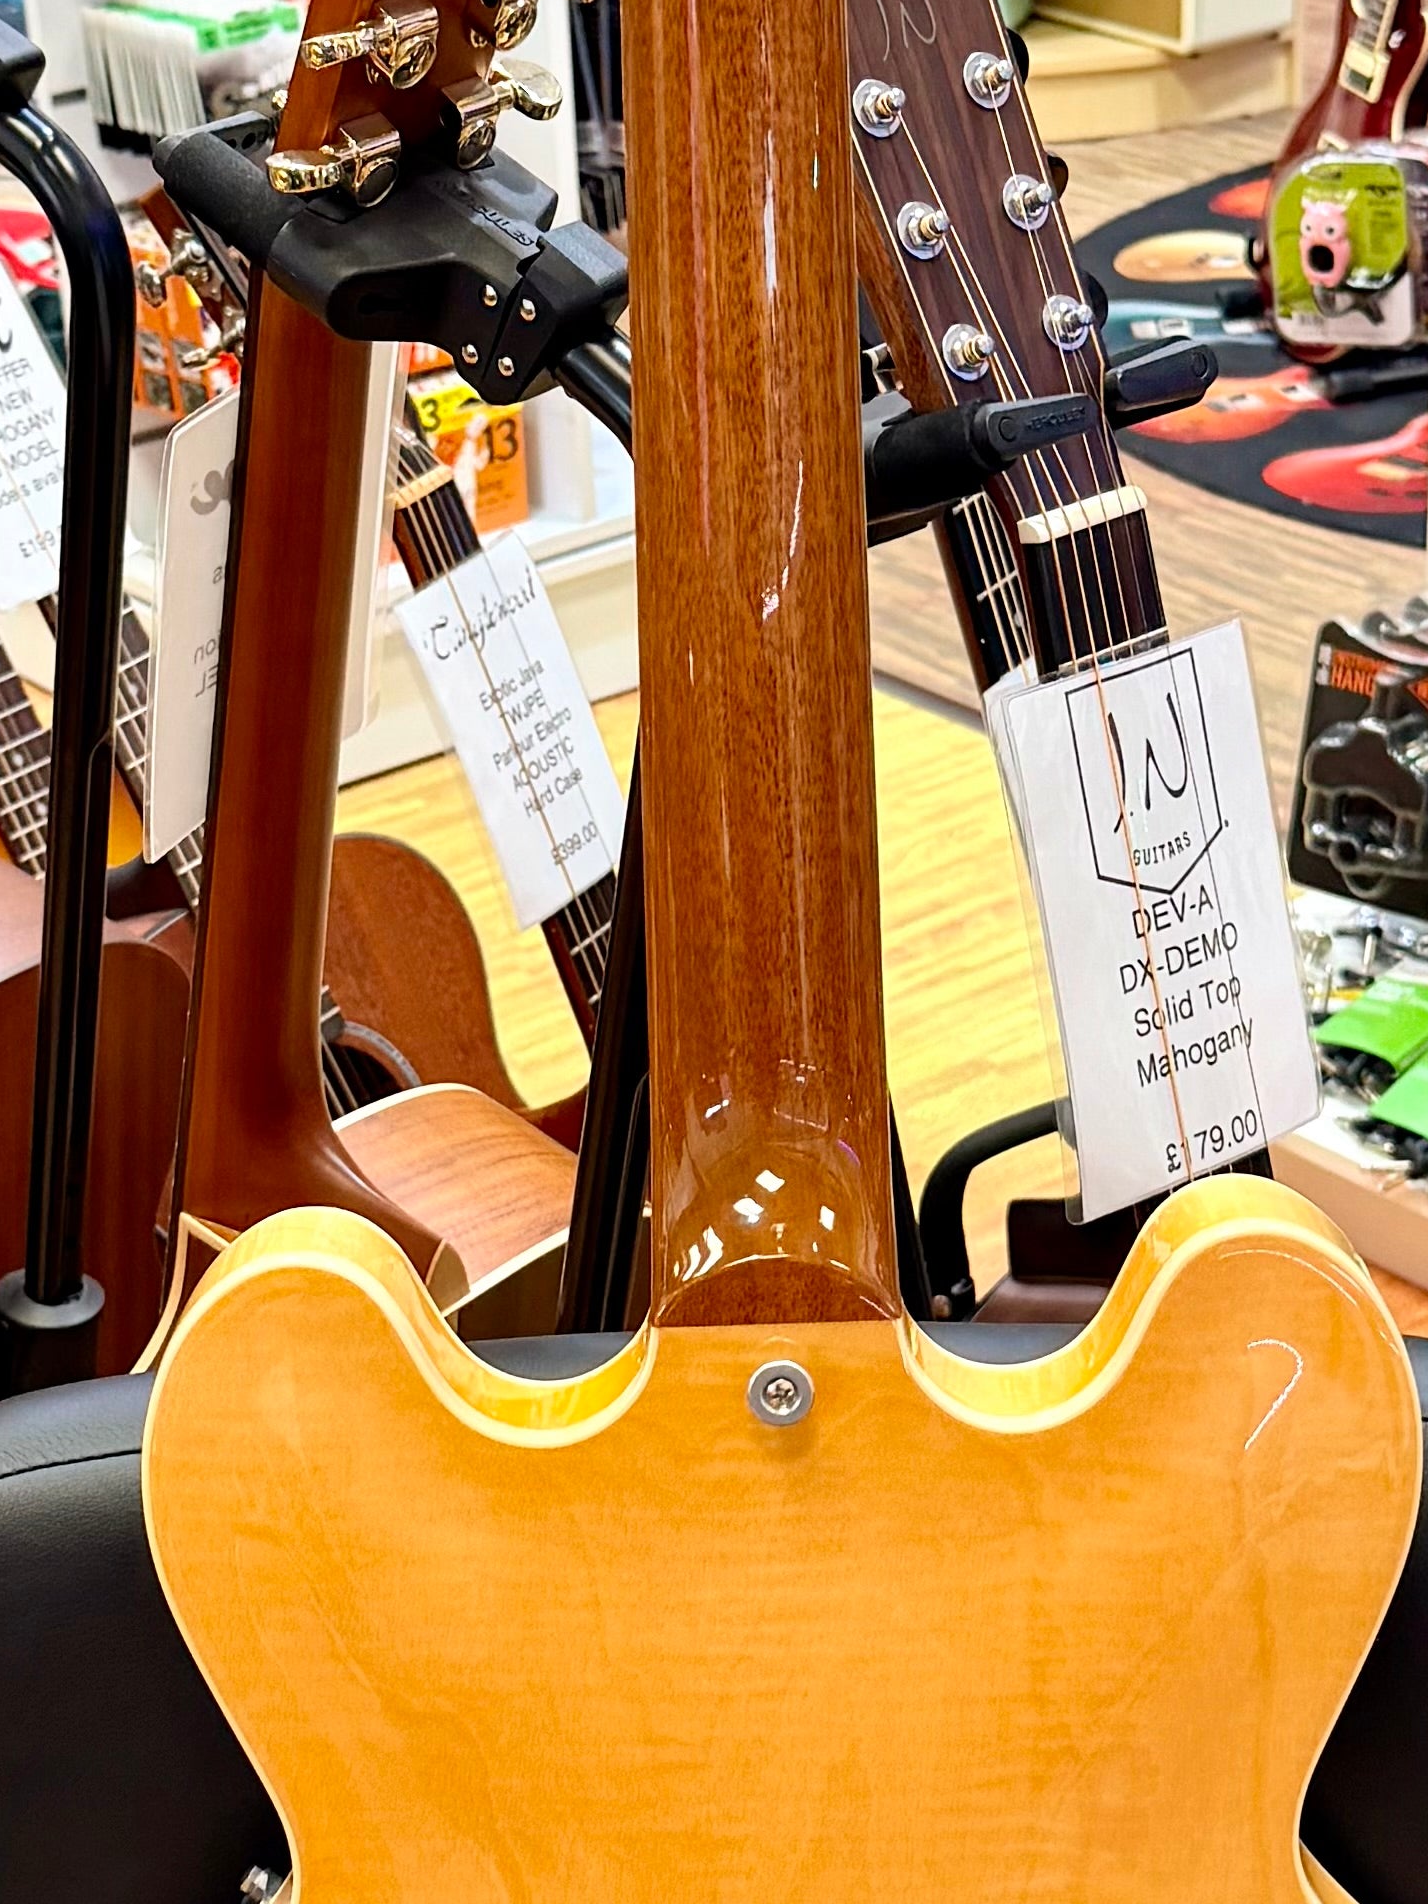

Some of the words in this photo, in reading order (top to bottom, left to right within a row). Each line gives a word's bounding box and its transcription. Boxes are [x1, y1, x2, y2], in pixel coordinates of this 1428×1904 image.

[7, 438, 60, 472] MODEL
[482, 417, 518, 464] 13
[518, 658, 545, 688] Java
[534, 705, 573, 741] Electro
[512, 735, 575, 793] ACOUSTIC
[554, 765, 584, 797] Case
[1132, 830, 1193, 868] GUITARS
[1131, 882, 1214, 941] DEV-A
[1118, 920, 1240, 995] DX-DEMO
[1133, 990, 1195, 1039] Solid
[1198, 974, 1243, 1020] Top
[1136, 1016, 1255, 1088] Mahogany
[1165, 1107, 1259, 1173] £179.00
